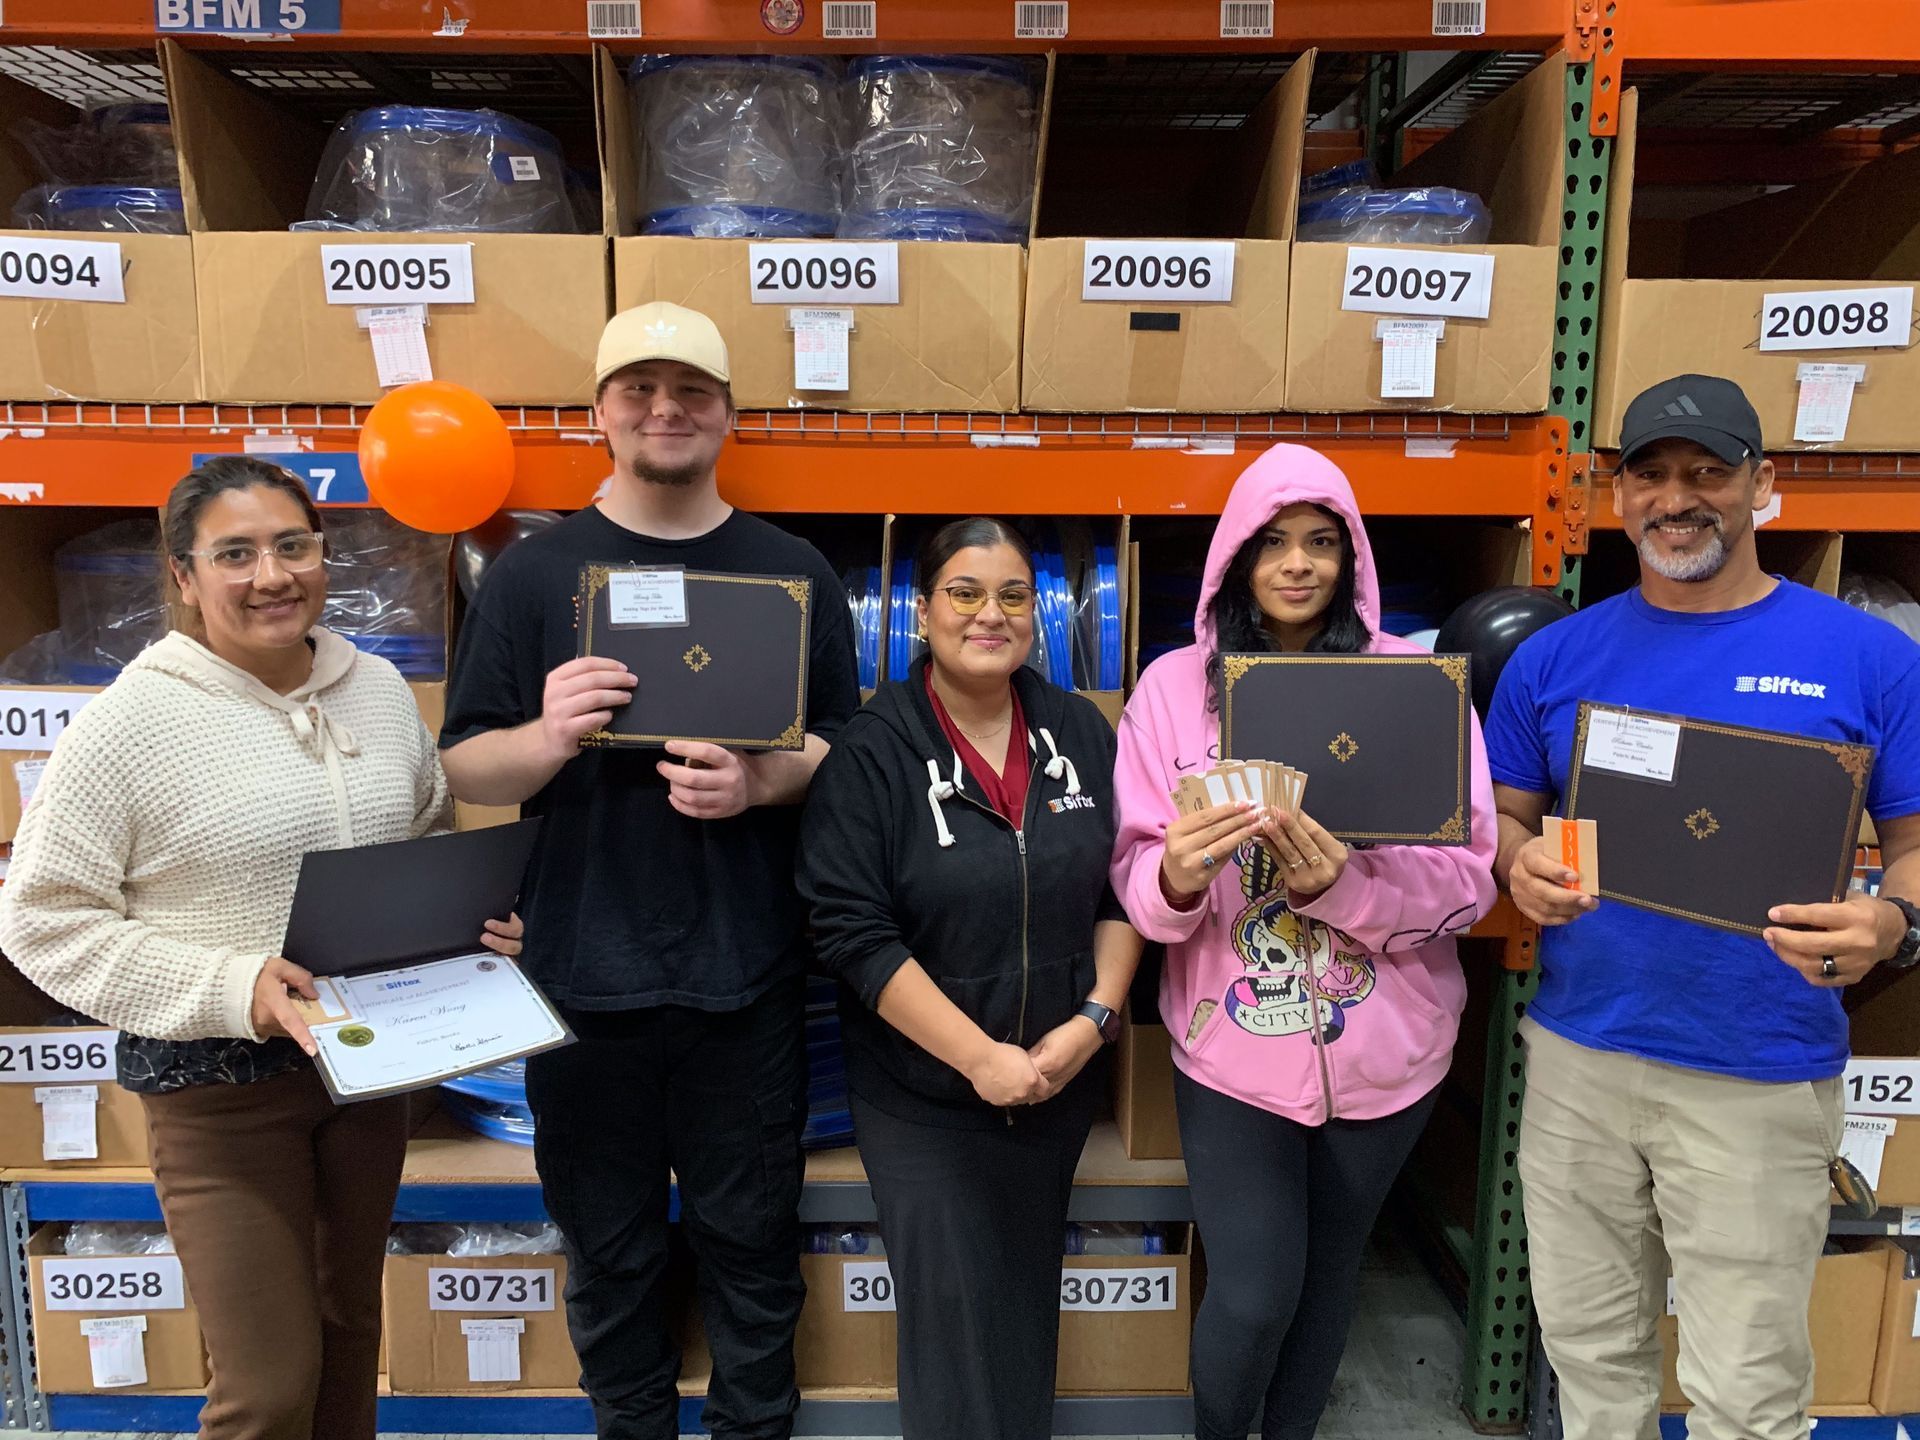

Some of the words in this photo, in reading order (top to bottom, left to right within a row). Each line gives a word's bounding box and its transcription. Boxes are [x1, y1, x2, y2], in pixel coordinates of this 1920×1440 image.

[159, 0, 260, 29] BFM
[279, 0, 306, 30] 5
[0, 251, 100, 288] 0094
[330, 258, 451, 291] 20095
[757, 257, 877, 290] 20096
[1089, 255, 1211, 289] 20096
[1349, 265, 1472, 302] 20097
[1766, 301, 1889, 338] 20098
[309, 468, 336, 501] 7
[1758, 676, 1826, 699] Siftex
[385, 977, 422, 990] Siftex
[1252, 1008, 1310, 1027] CITY
[0, 1043, 107, 1071] 21596
[1848, 1075, 1914, 1103] 152
[50, 1272, 163, 1300] 30258
[437, 1274, 546, 1302] 30731
[850, 1276, 891, 1302] 30
[1061, 1276, 1169, 1304] 30731
